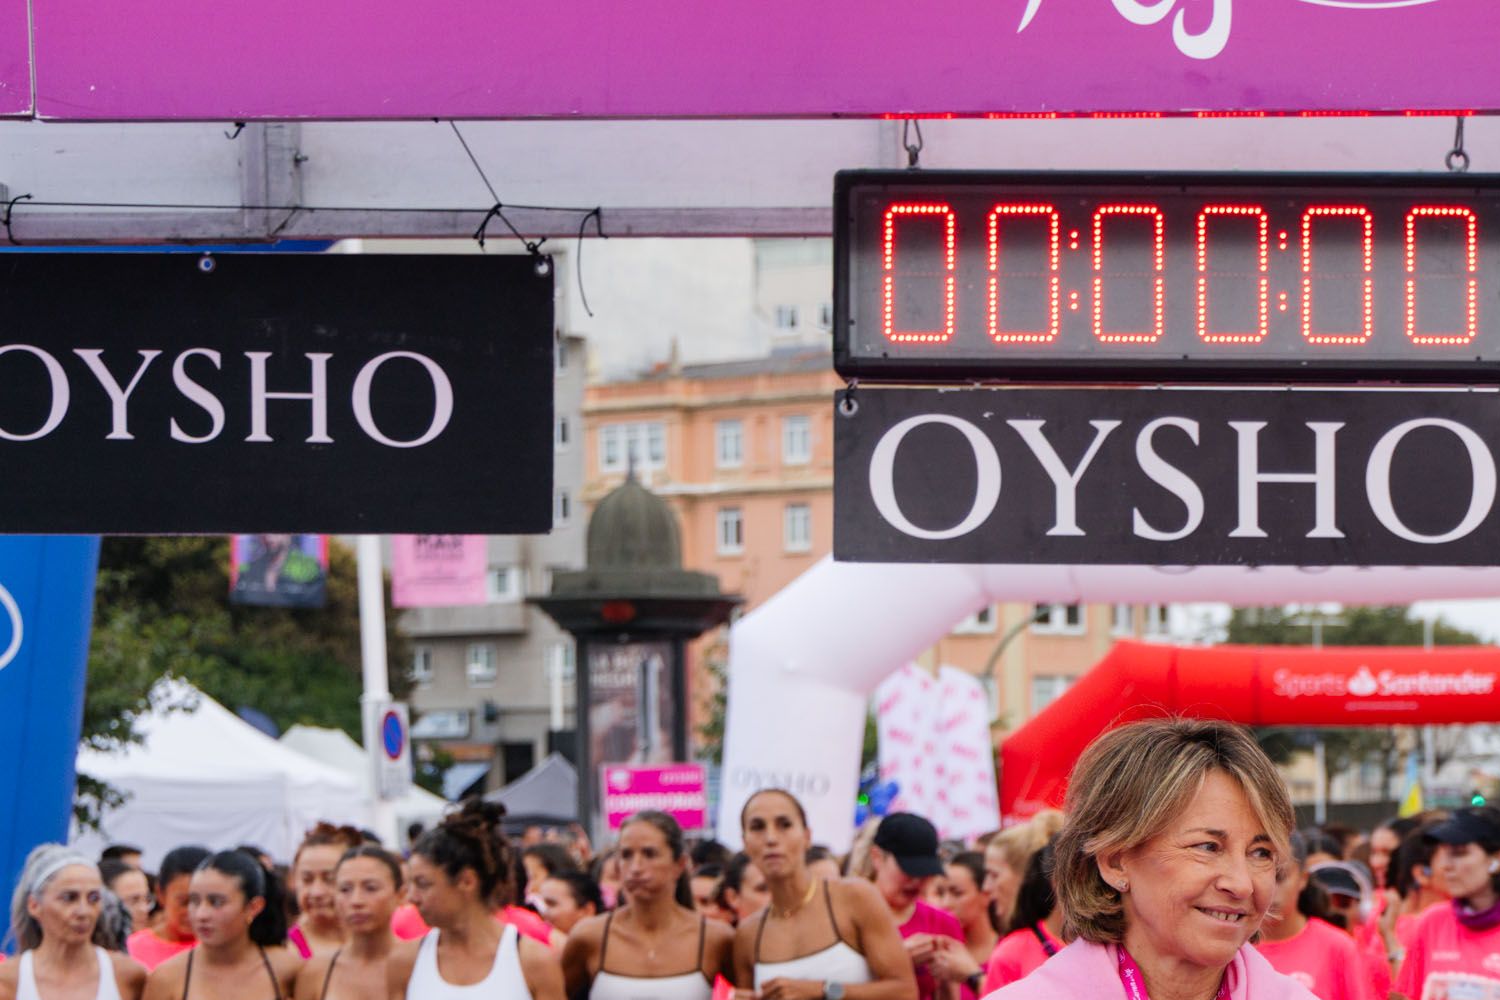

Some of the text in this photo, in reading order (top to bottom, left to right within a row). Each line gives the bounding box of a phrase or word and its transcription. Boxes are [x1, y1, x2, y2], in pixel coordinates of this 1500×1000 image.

[0, 345, 453, 447] OYSHO
[869, 414, 1497, 543] OYSHO
[1273, 669, 1496, 698] Sports Santander
